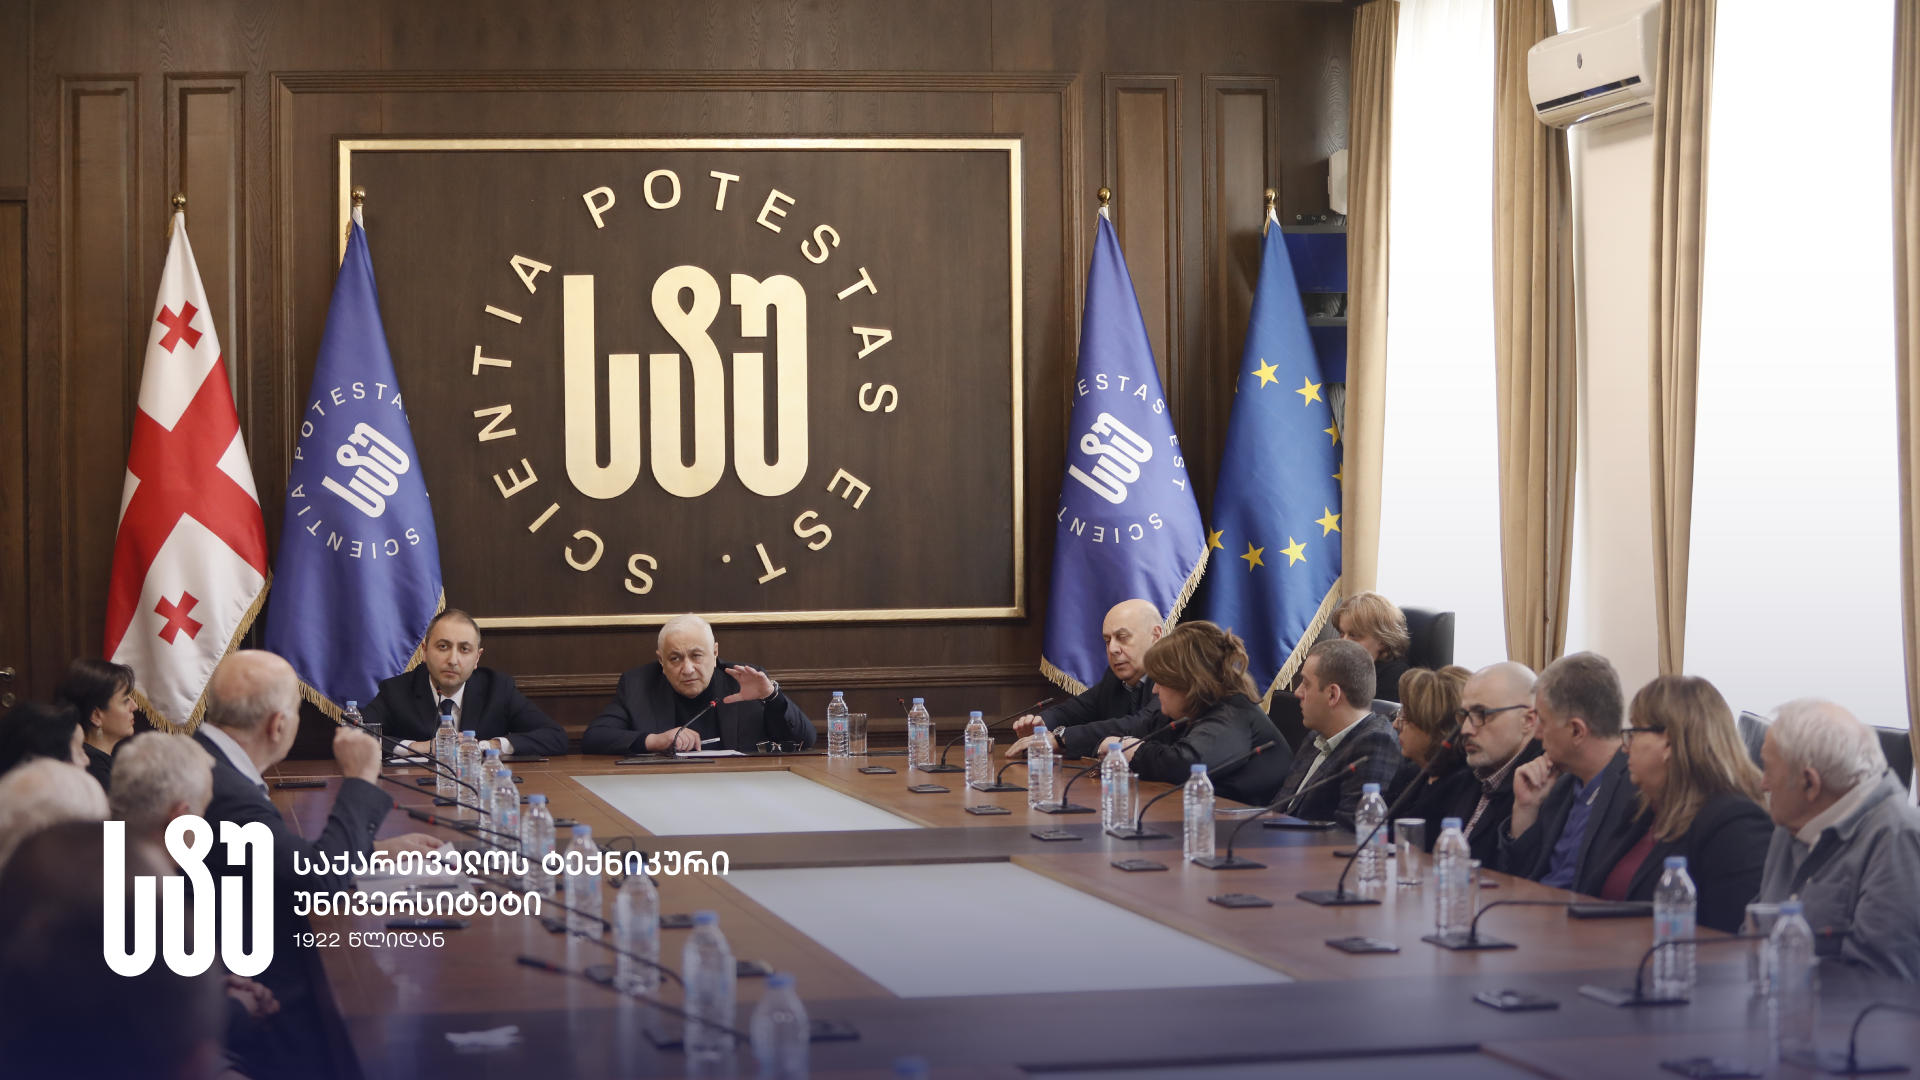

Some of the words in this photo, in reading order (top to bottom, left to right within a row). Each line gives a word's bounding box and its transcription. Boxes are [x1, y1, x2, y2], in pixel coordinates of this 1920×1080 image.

[472, 254, 658, 595] SCIENTIA
[582, 169, 899, 413] POTESTAS
[1072, 373, 1166, 415] ESTAS
[295, 381, 409, 461] POTESTA
[291, 484, 421, 560] SCIENTIA
[1057, 506, 1164, 544] SCIENT
